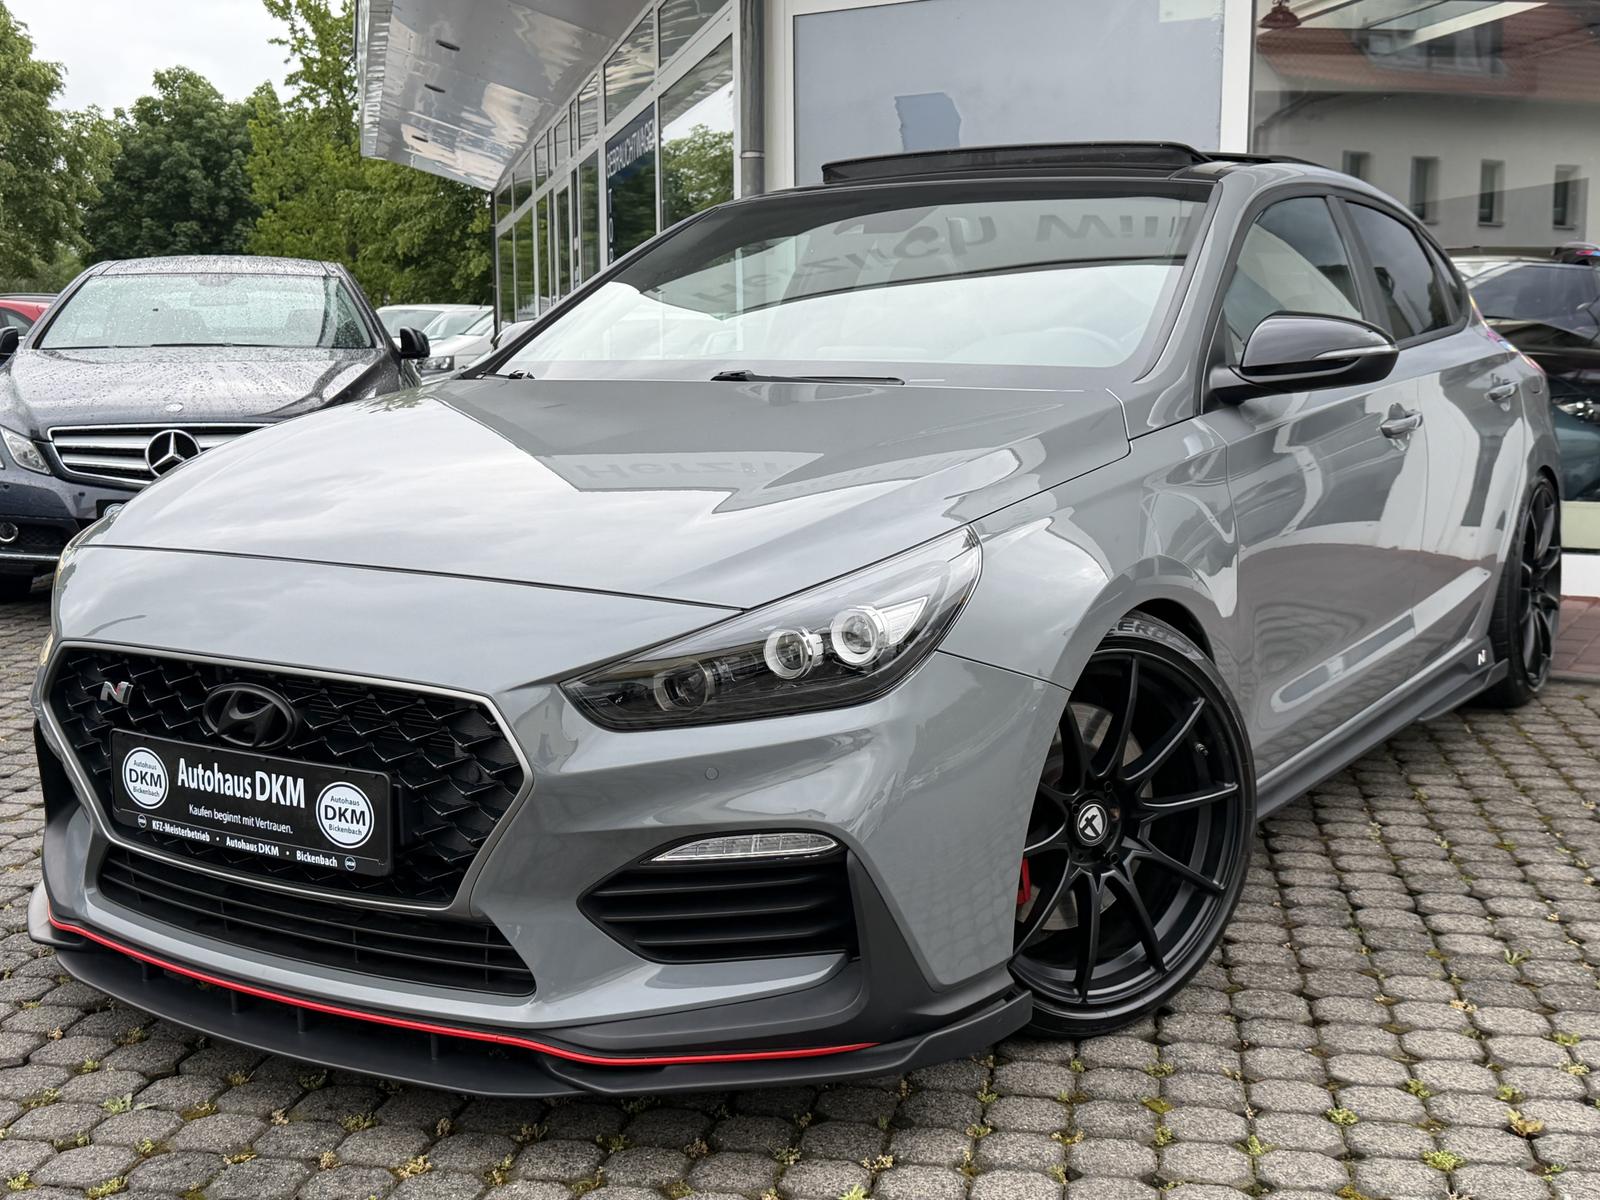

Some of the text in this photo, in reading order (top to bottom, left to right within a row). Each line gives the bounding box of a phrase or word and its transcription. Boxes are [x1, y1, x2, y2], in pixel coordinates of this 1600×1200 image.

[129, 768, 162, 789] DKM
[177, 757, 306, 809] Autohaus DKM
[330, 795, 360, 806] Autohaus
[188, 803, 294, 834] Kaufen beginnt mit Vertrauen.
[324, 804, 366, 827] DKM
[328, 823, 363, 836] Bickenbach
[151, 819, 211, 843] KFZ-Meisterbetrieb
[225, 836, 258, 853] Autohaus
[258, 844, 280, 858] DKM
[296, 850, 338, 868] Bickenbach
